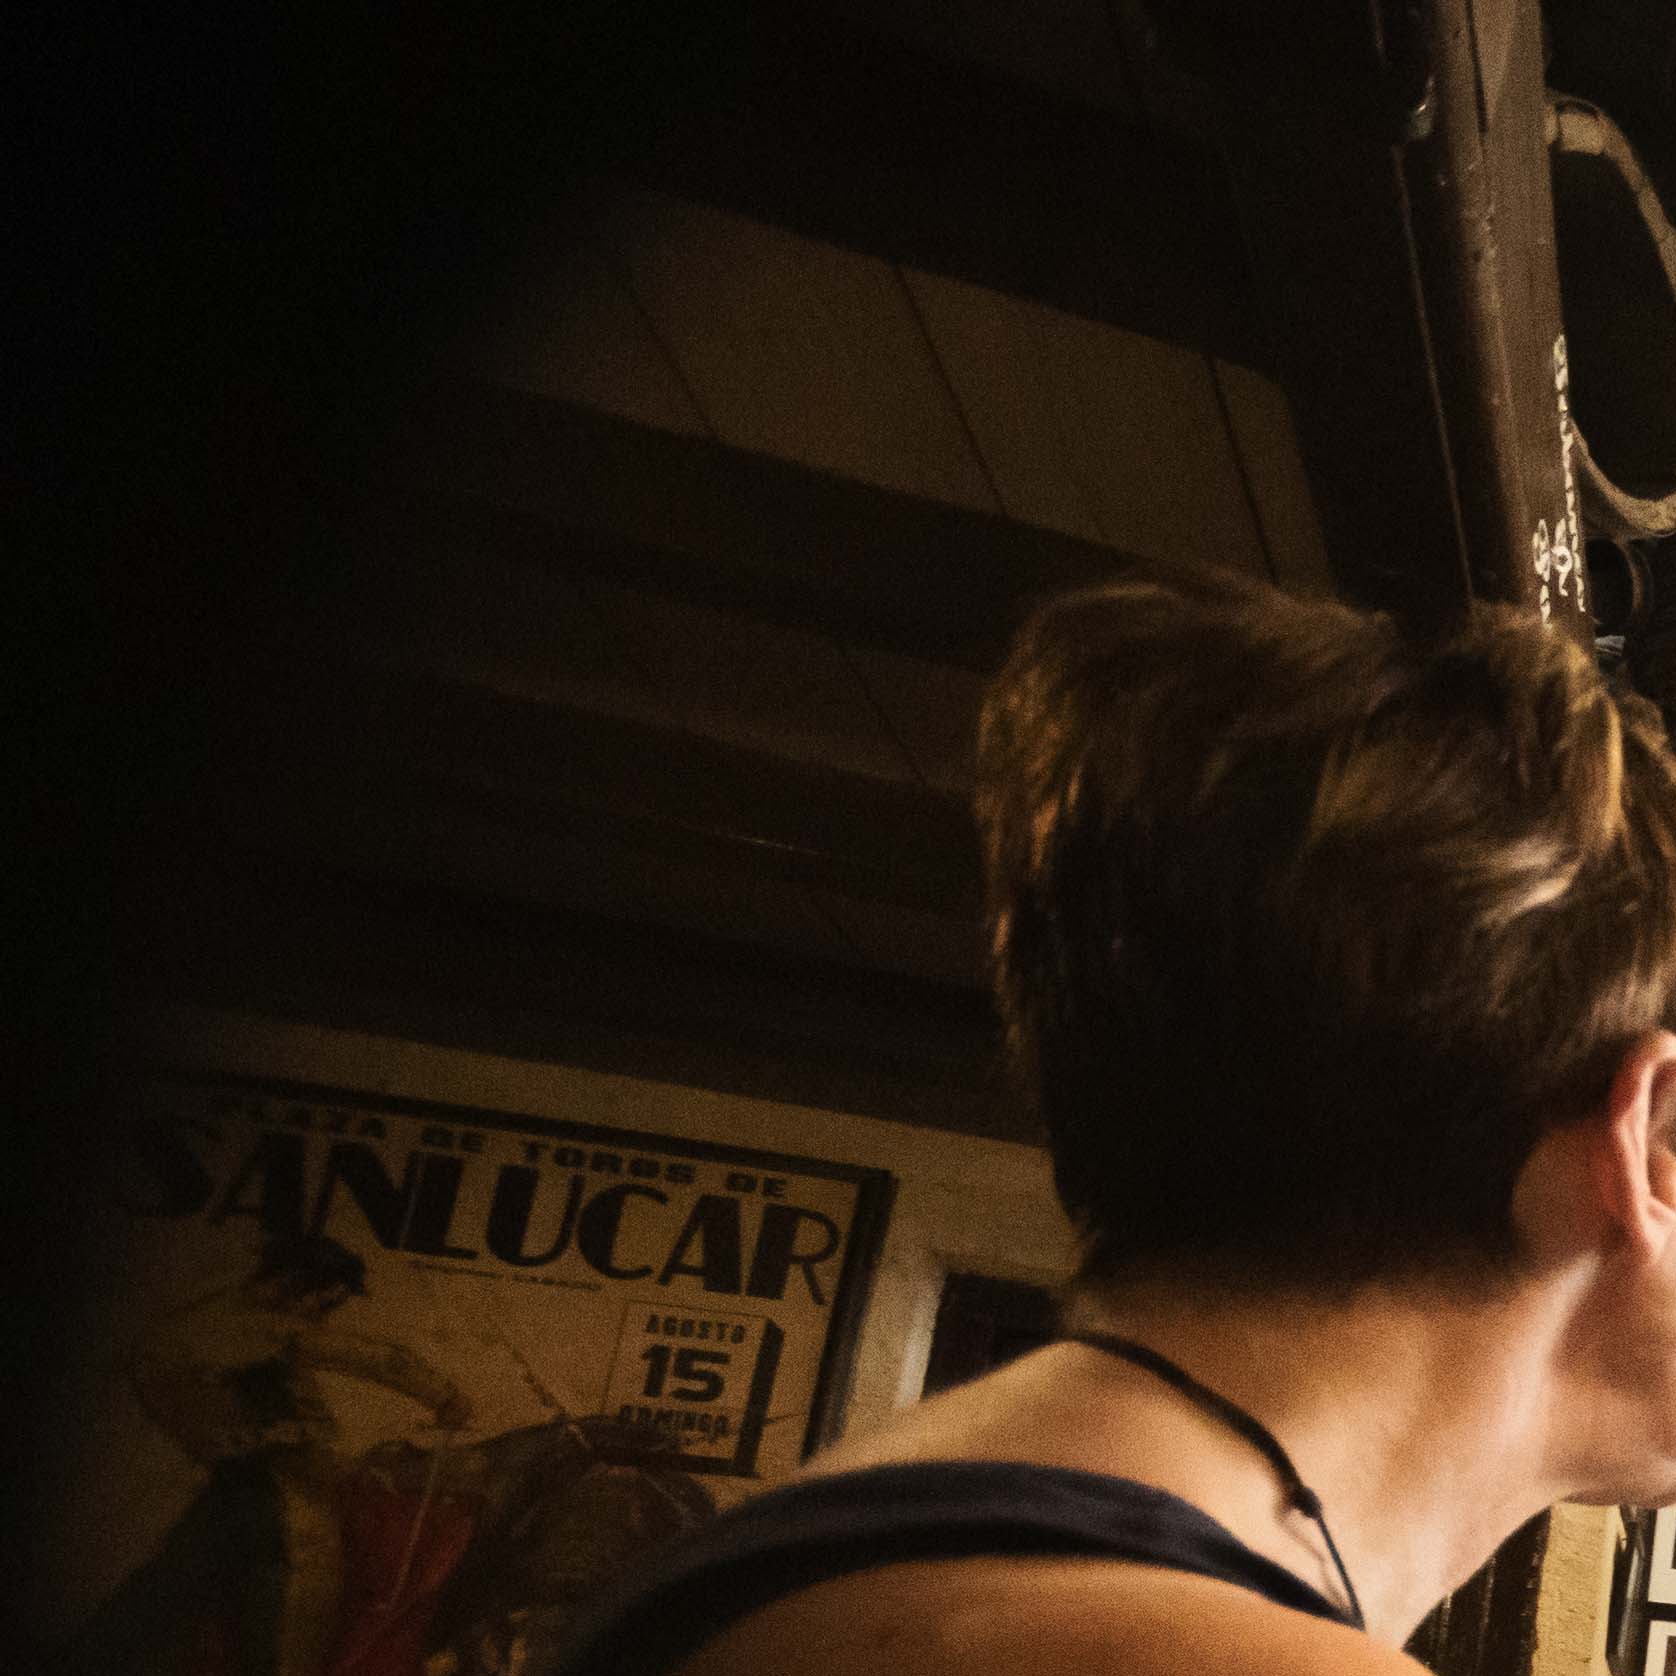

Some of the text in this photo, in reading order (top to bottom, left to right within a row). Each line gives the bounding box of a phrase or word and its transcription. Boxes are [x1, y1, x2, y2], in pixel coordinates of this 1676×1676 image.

[420, 1124, 486, 1156] DE
[521, 1140, 697, 1184] TOROS
[726, 1173, 789, 1201] DE
[644, 1313, 747, 1345] AGOSTO
[639, 1344, 732, 1403] 15
